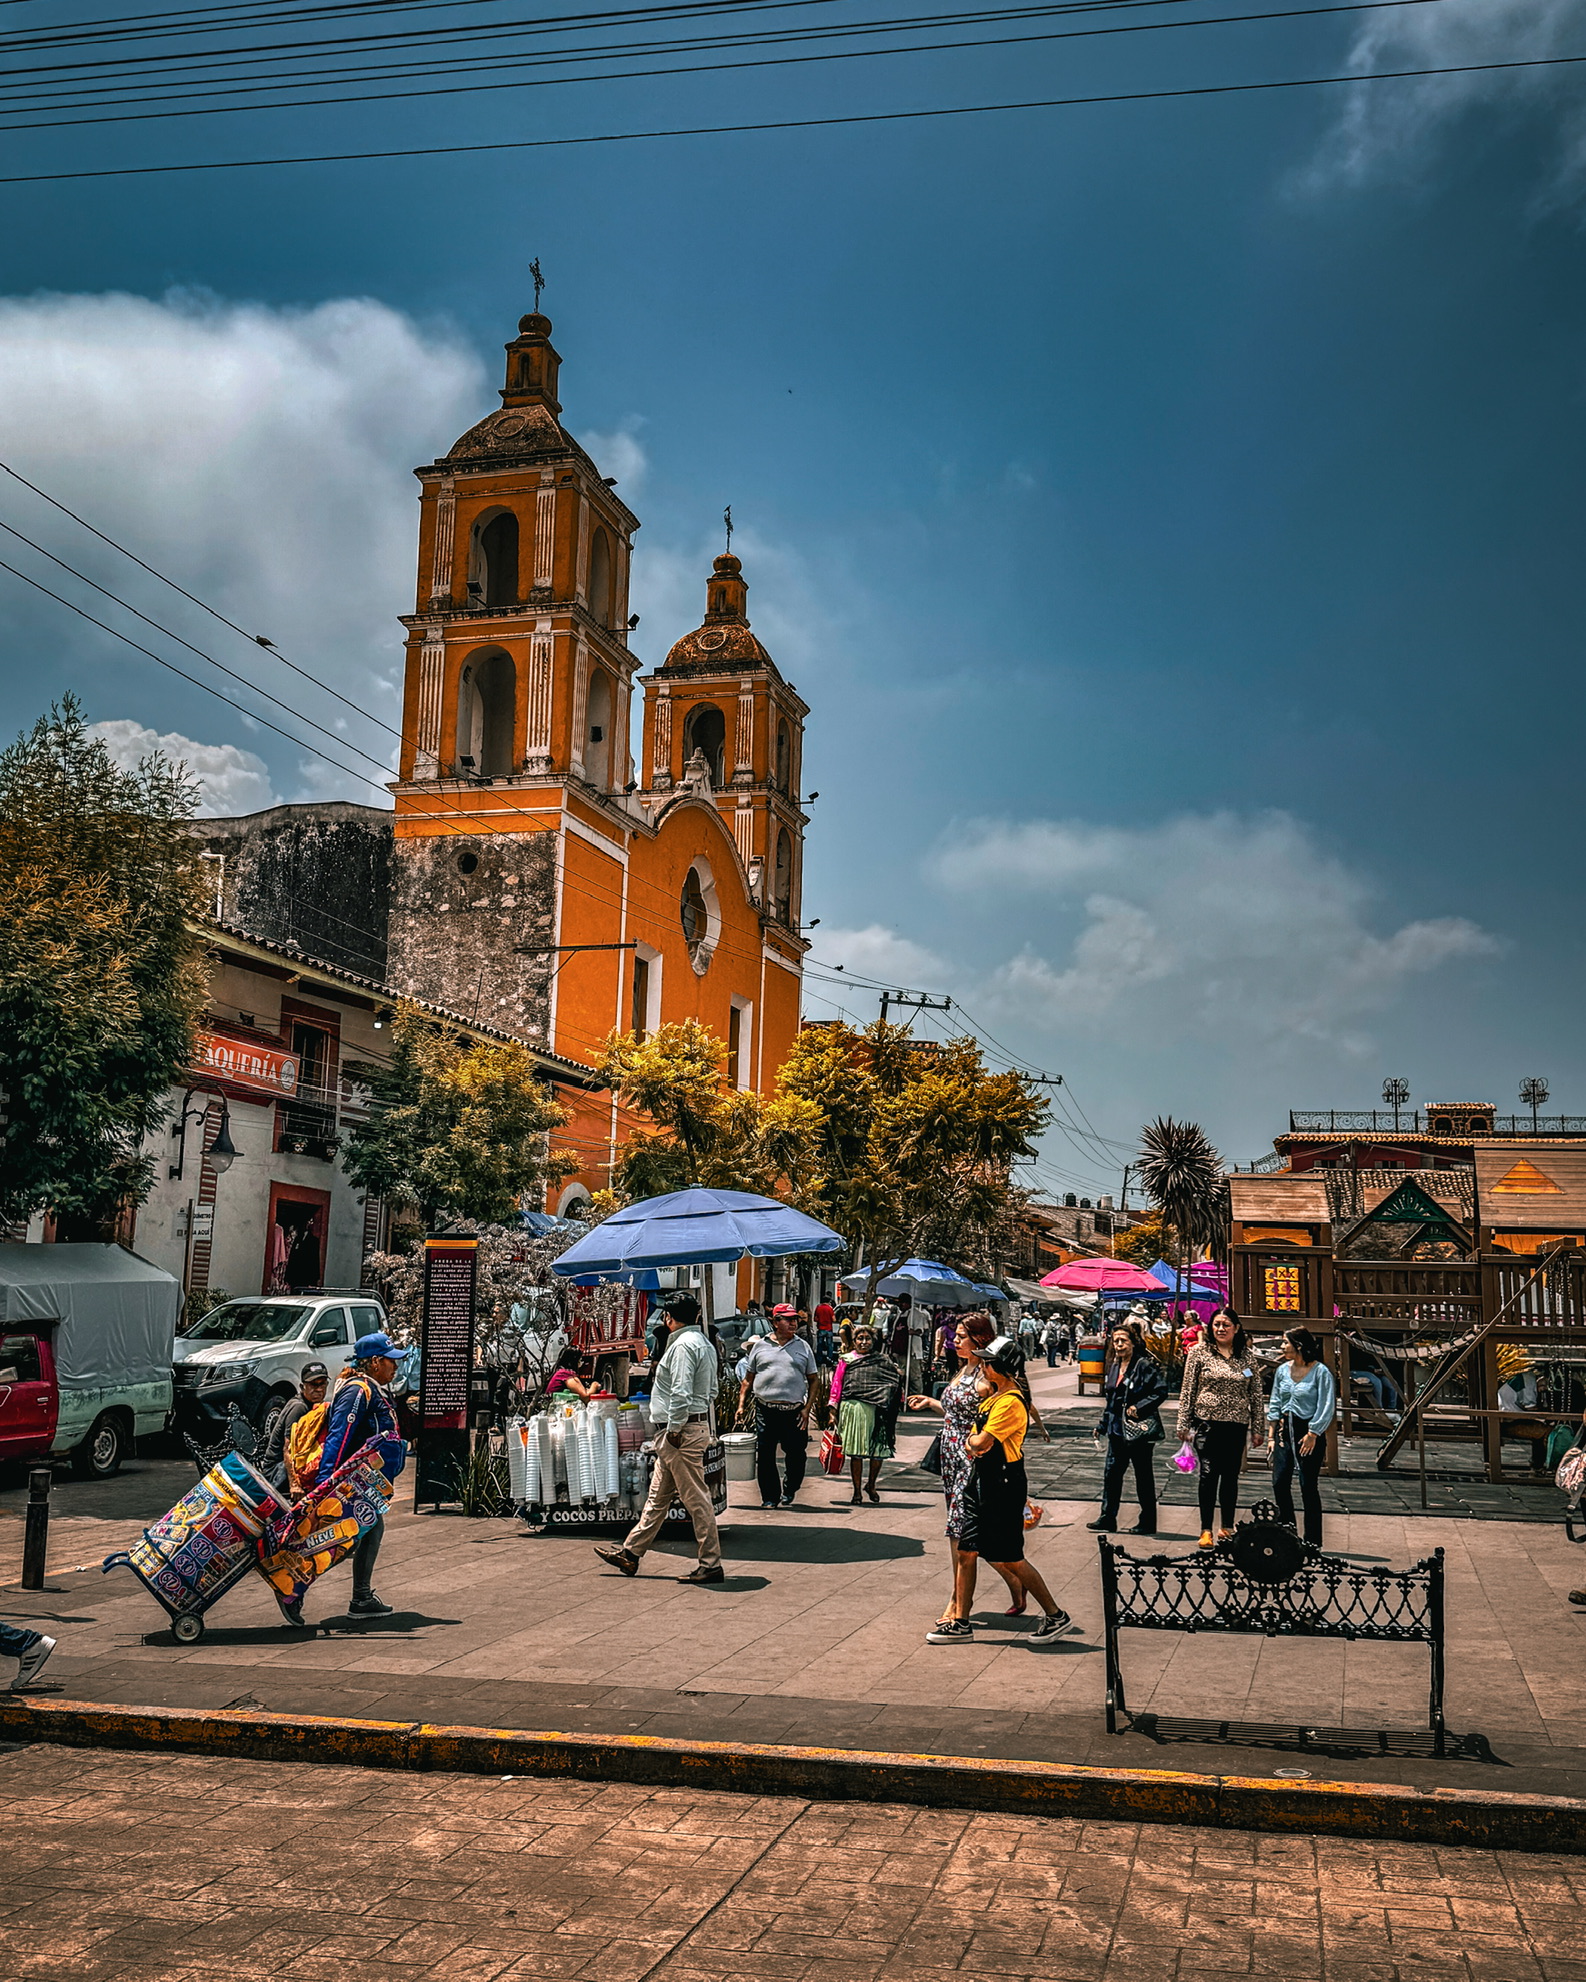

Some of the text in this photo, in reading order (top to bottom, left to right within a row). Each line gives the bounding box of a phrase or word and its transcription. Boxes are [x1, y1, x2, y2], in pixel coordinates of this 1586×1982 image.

[198, 1043, 278, 1082] AQUERÍA
[356, 1503, 375, 1525] $10
[552, 1509, 596, 1522] COCOS
[598, 1508, 686, 1522] PREPAOS
[213, 1520, 232, 1538] $10
[193, 1540, 211, 1557] $10
[177, 1557, 195, 1574] $10
